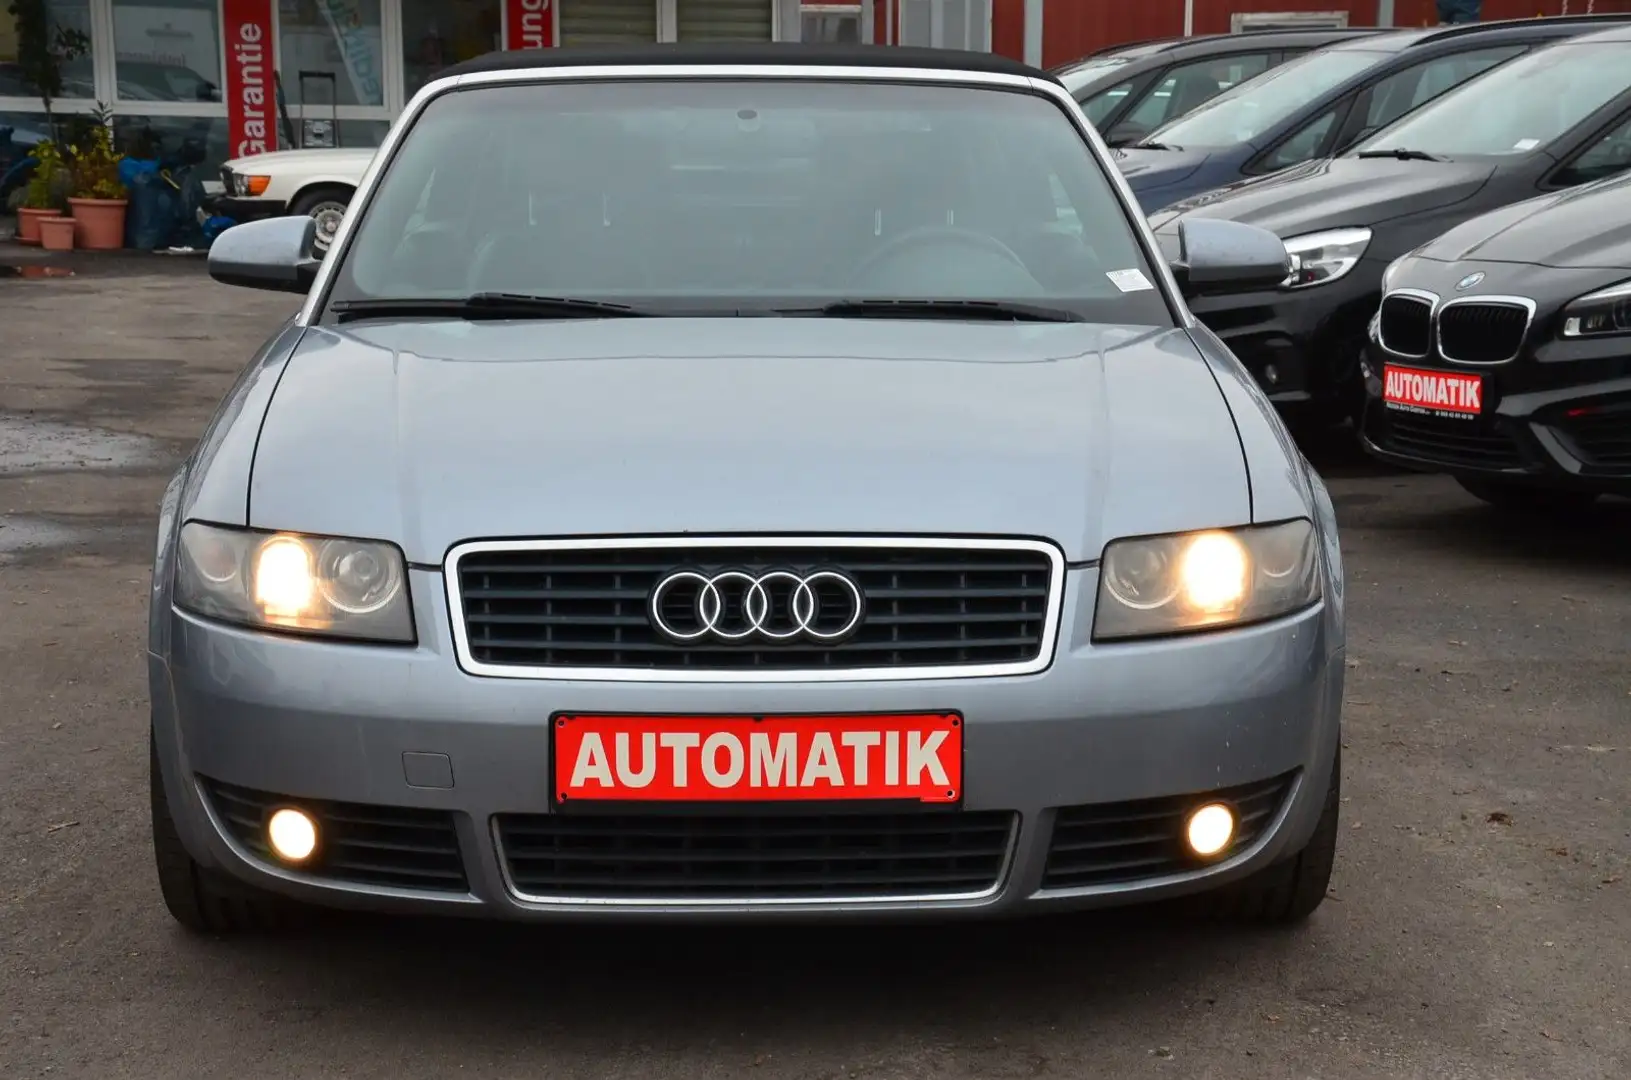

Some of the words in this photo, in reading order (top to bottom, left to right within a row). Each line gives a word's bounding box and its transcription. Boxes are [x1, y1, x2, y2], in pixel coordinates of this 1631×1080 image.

[234, 23, 265, 159] Garantie
[1386, 371, 1480, 408] AUTOMATIK
[569, 731, 950, 788] AUTOMATIK
